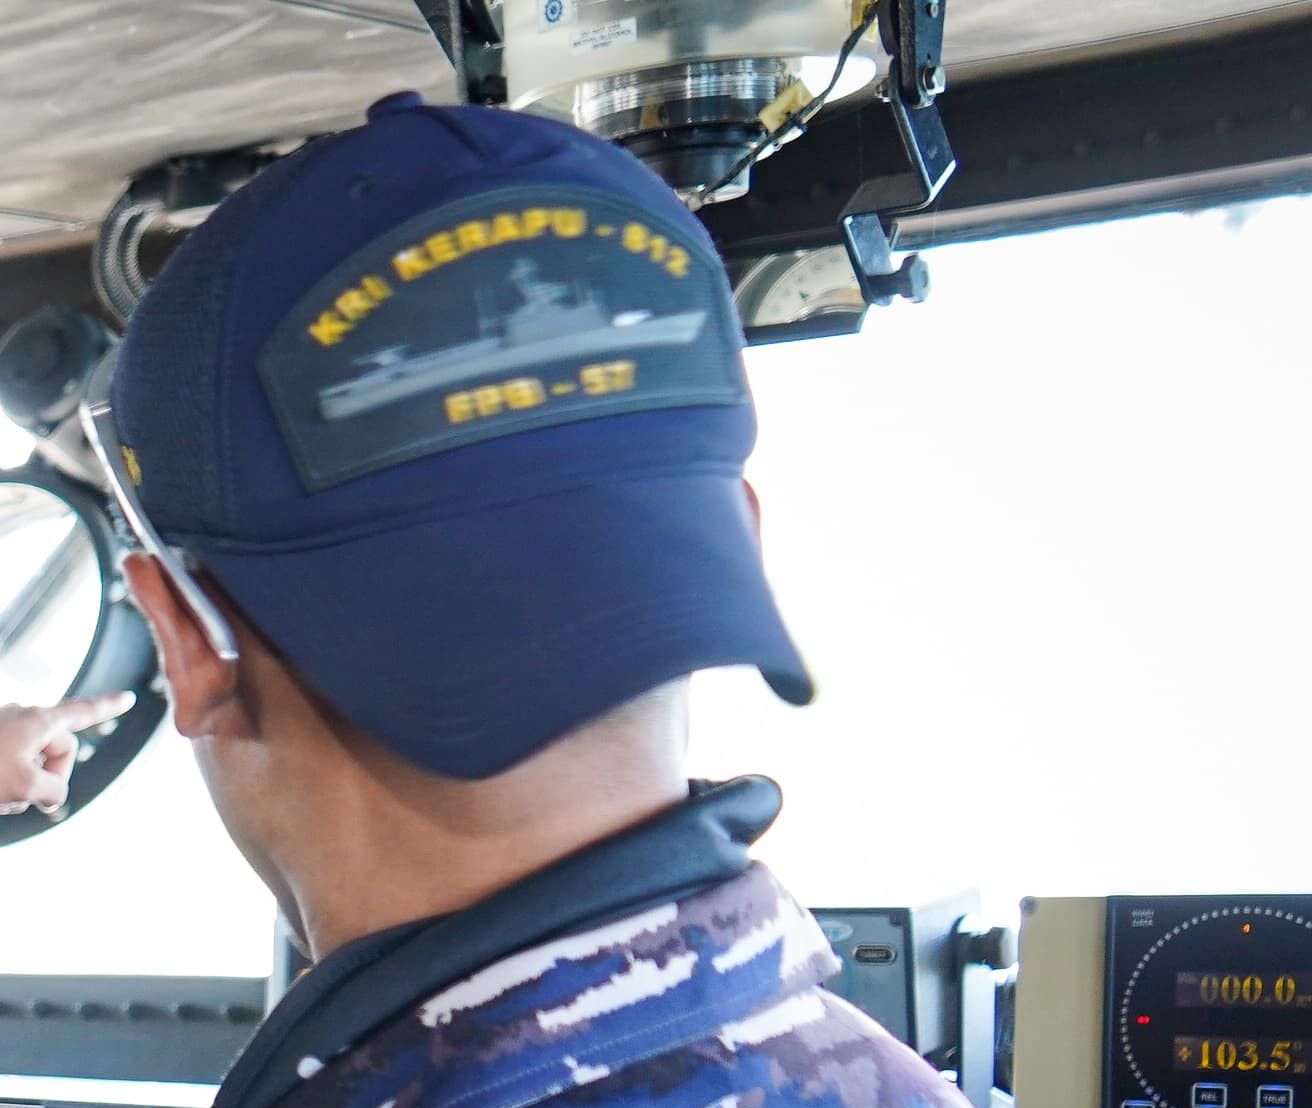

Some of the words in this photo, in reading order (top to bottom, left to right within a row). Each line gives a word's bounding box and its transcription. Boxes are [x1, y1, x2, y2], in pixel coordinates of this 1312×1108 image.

[308, 275, 394, 347] KRI
[391, 208, 587, 281] KERAPU
[621, 222, 690, 278] 812
[445, 377, 545, 424] FPB
[580, 360, 636, 396] 57
[1262, 1094, 1287, 1105] TRUE
